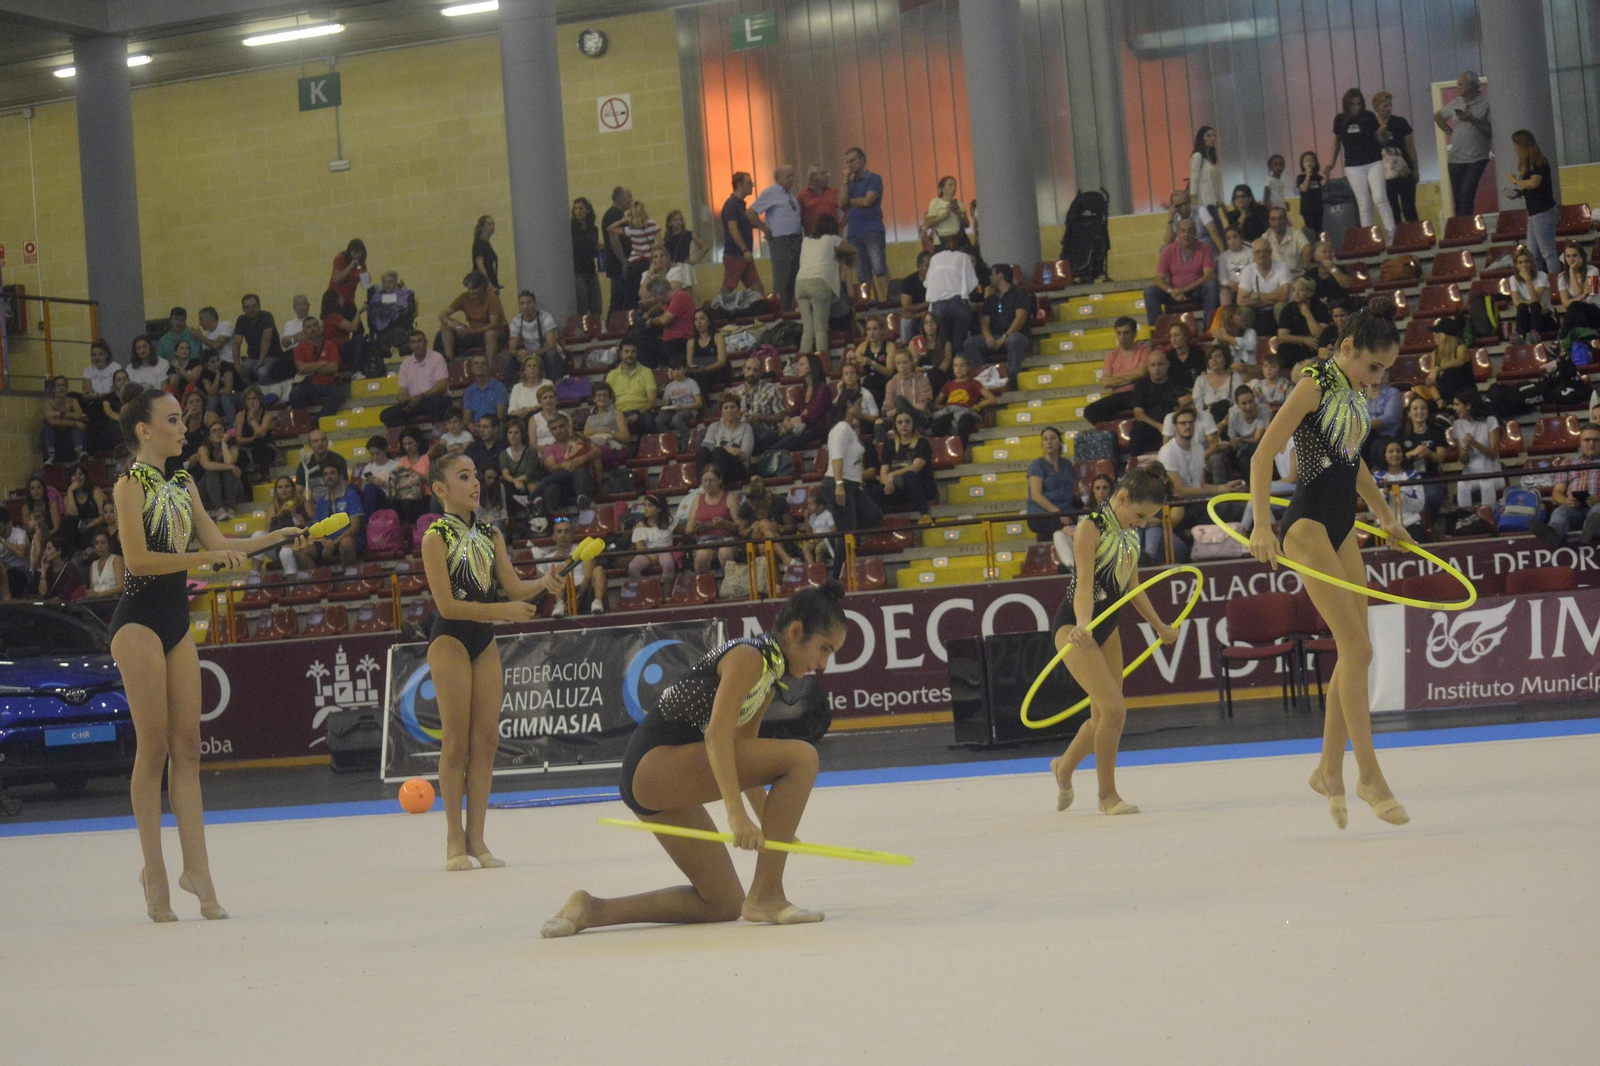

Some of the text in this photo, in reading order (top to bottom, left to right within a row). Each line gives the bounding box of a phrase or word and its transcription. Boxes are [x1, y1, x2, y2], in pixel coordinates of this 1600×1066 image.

[744, 18, 763, 43] L
[310, 80, 328, 105] K
[1170, 570, 1303, 605] PALACIO
[1493, 546, 1600, 575] DEPOR
[504, 657, 603, 686] FEDERACIÓN
[500, 686, 604, 713] ANDALUZA
[853, 685, 952, 712] Deportes
[1427, 679, 1514, 700] Instituto
[71, 731, 90, 740] C-HR
[498, 713, 603, 739] GIMNASIA
